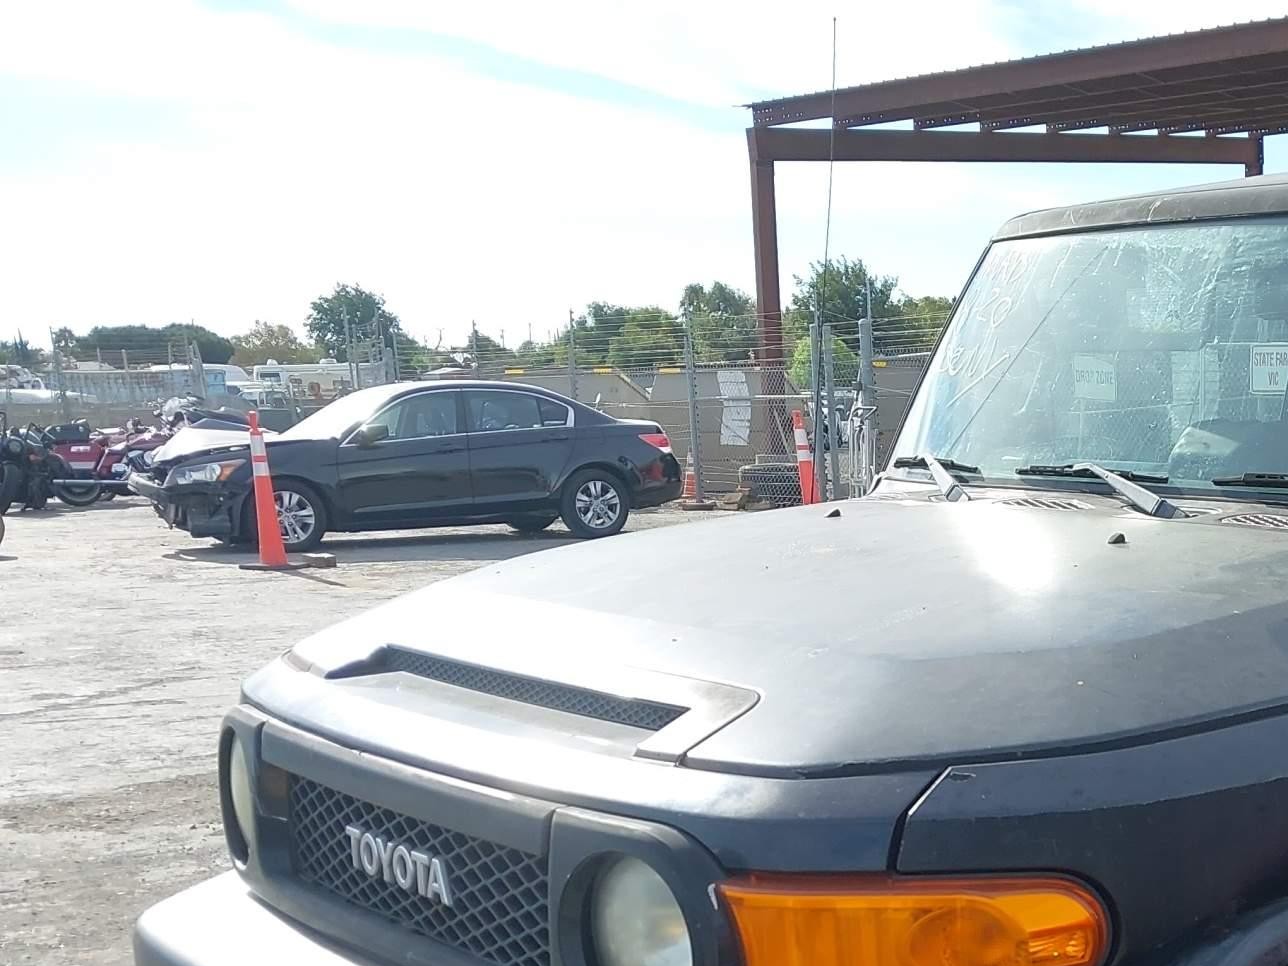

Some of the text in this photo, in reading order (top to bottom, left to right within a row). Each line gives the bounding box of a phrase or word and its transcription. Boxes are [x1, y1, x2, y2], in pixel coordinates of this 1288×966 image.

[1254, 352, 1274, 367] STATE
[1268, 371, 1279, 386] VIC
[345, 825, 452, 906] TOYOTA
